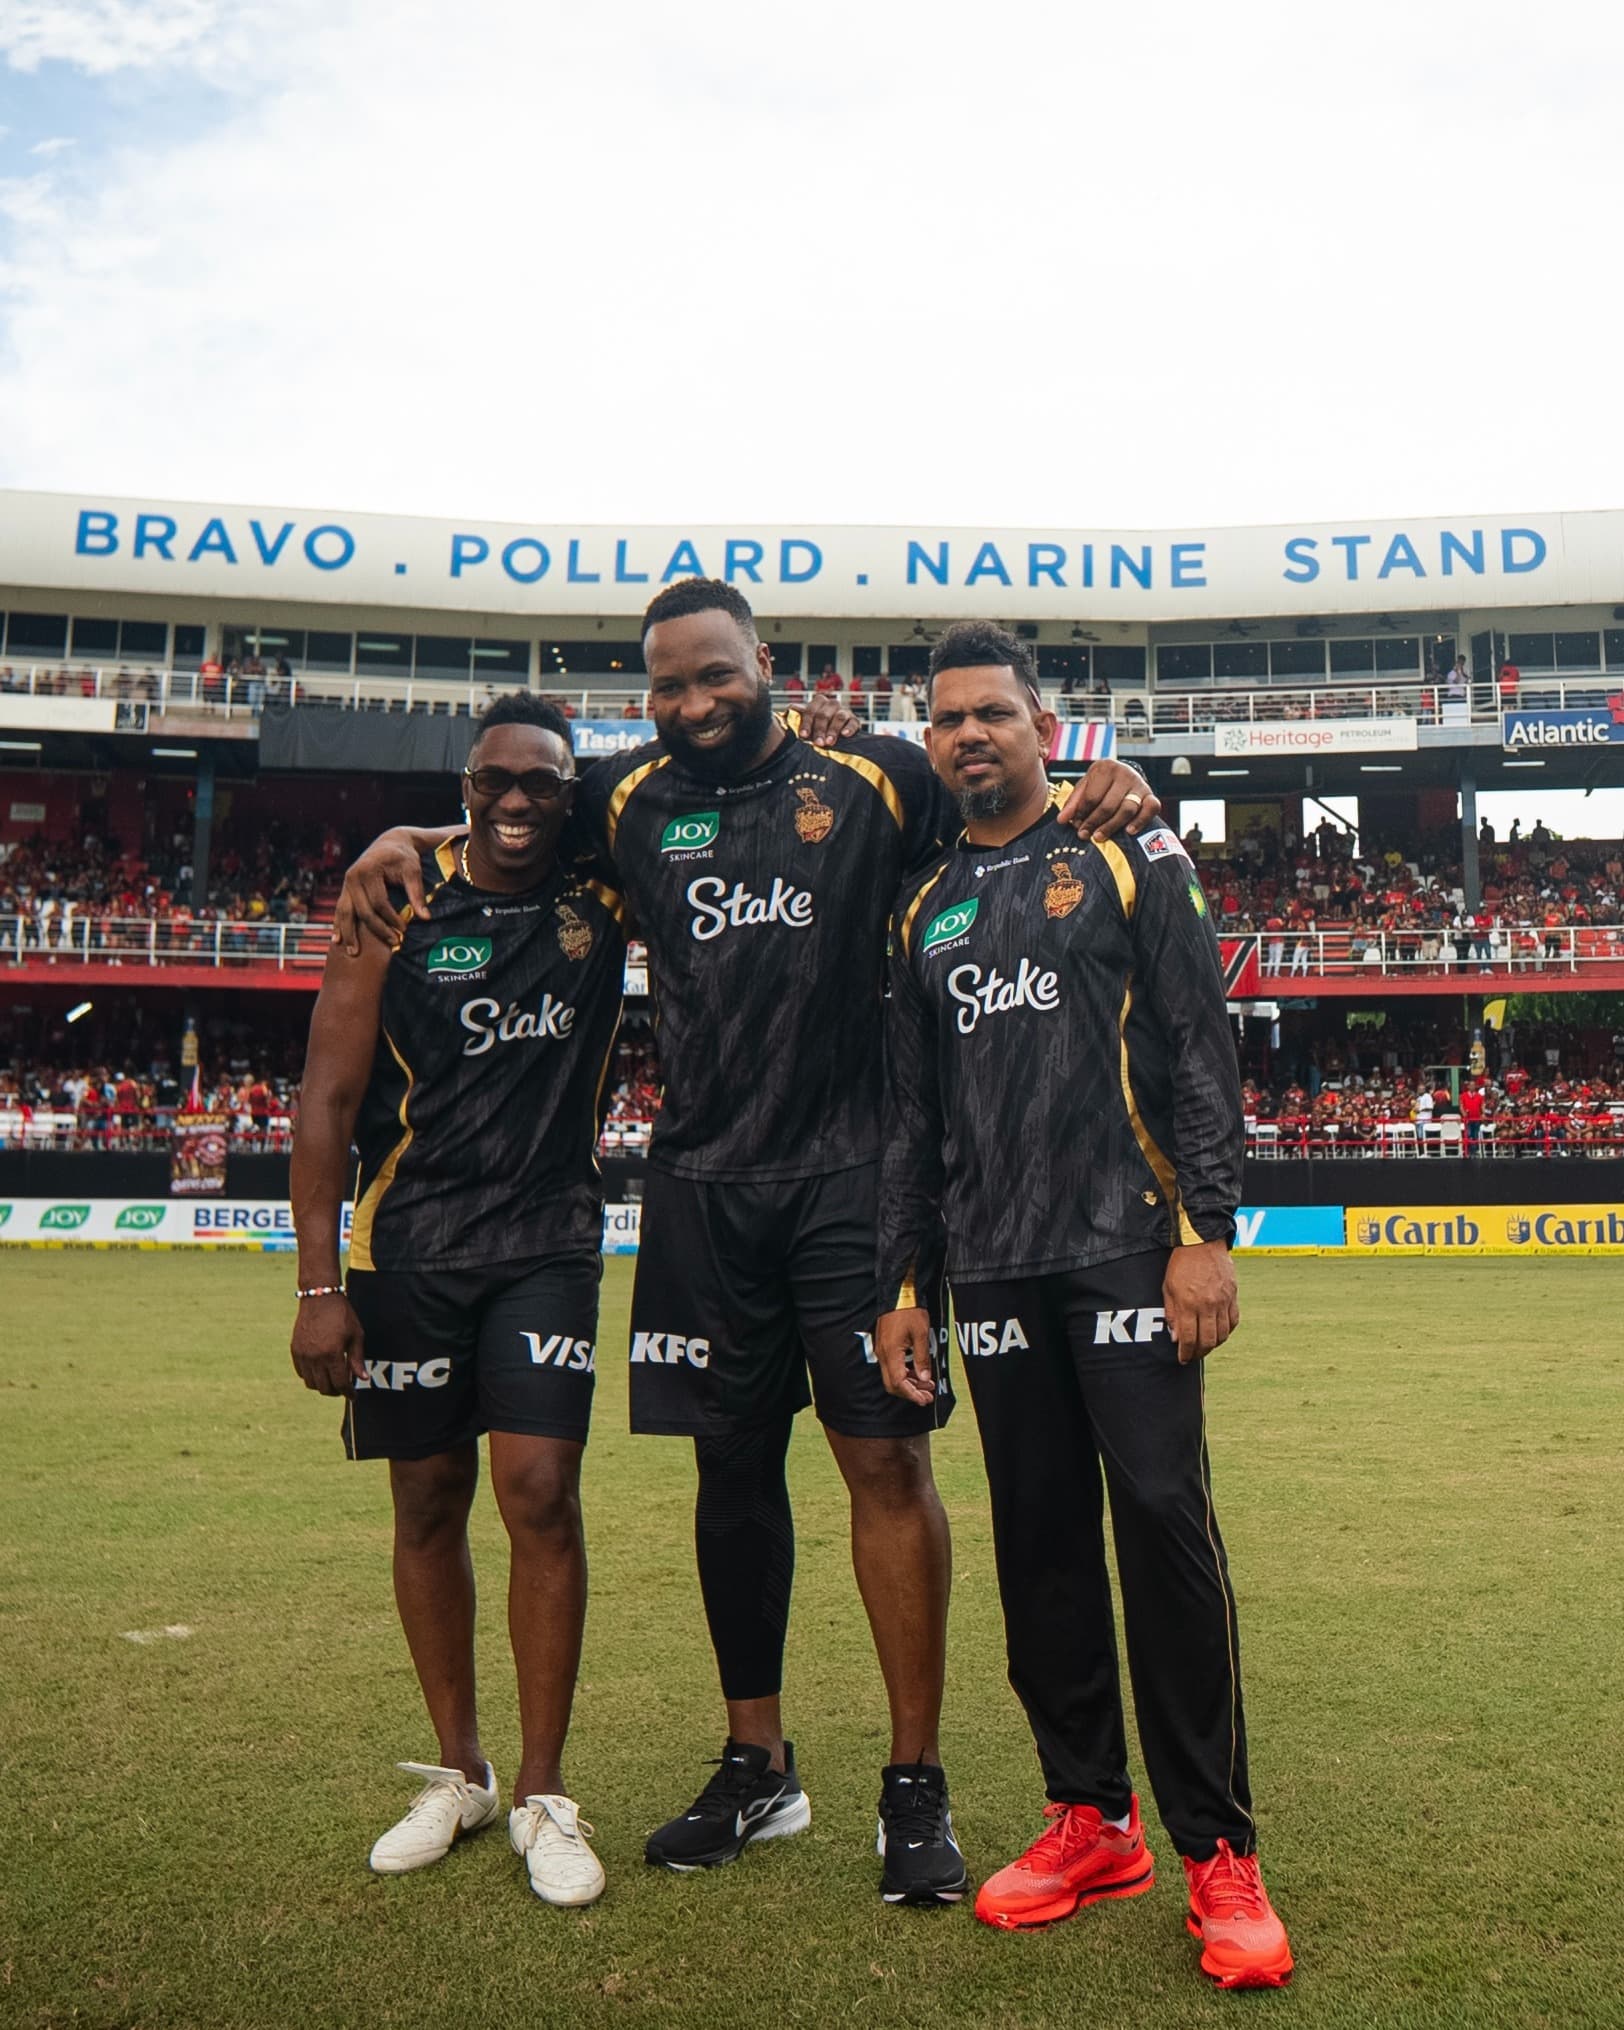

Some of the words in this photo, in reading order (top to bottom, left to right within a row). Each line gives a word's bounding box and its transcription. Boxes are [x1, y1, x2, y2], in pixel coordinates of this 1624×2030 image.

[75, 510, 355, 570] BRAVO
[449, 534, 823, 584] POLLARD
[906, 541, 1207, 589] NARINE
[1283, 528, 1547, 583] STAND
[1250, 729, 1333, 748] Heritage
[1340, 728, 1391, 738] PETROLEUM
[1509, 717, 1610, 745] Atlantic
[667, 821, 714, 841] JOY
[669, 849, 714, 862] SKINCARE
[687, 876, 814, 940] Stake
[928, 908, 972, 940] JOY
[434, 945, 486, 962] JOY
[928, 936, 970, 959] SKINCARE
[437, 970, 488, 984] SKINCARE
[948, 957, 1060, 1034] Stake
[460, 993, 576, 1056] Stake
[43, 1208, 87, 1227] JOY
[119, 1208, 162, 1227] JOY
[194, 1207, 291, 1228] BERGE
[1385, 1214, 1480, 1246] Carib
[1535, 1212, 1624, 1245] Carib
[954, 1317, 1030, 1357] VISA
[1093, 1307, 1172, 1344] KF
[630, 1331, 710, 1369] KFC
[354, 1357, 451, 1391] KFC
